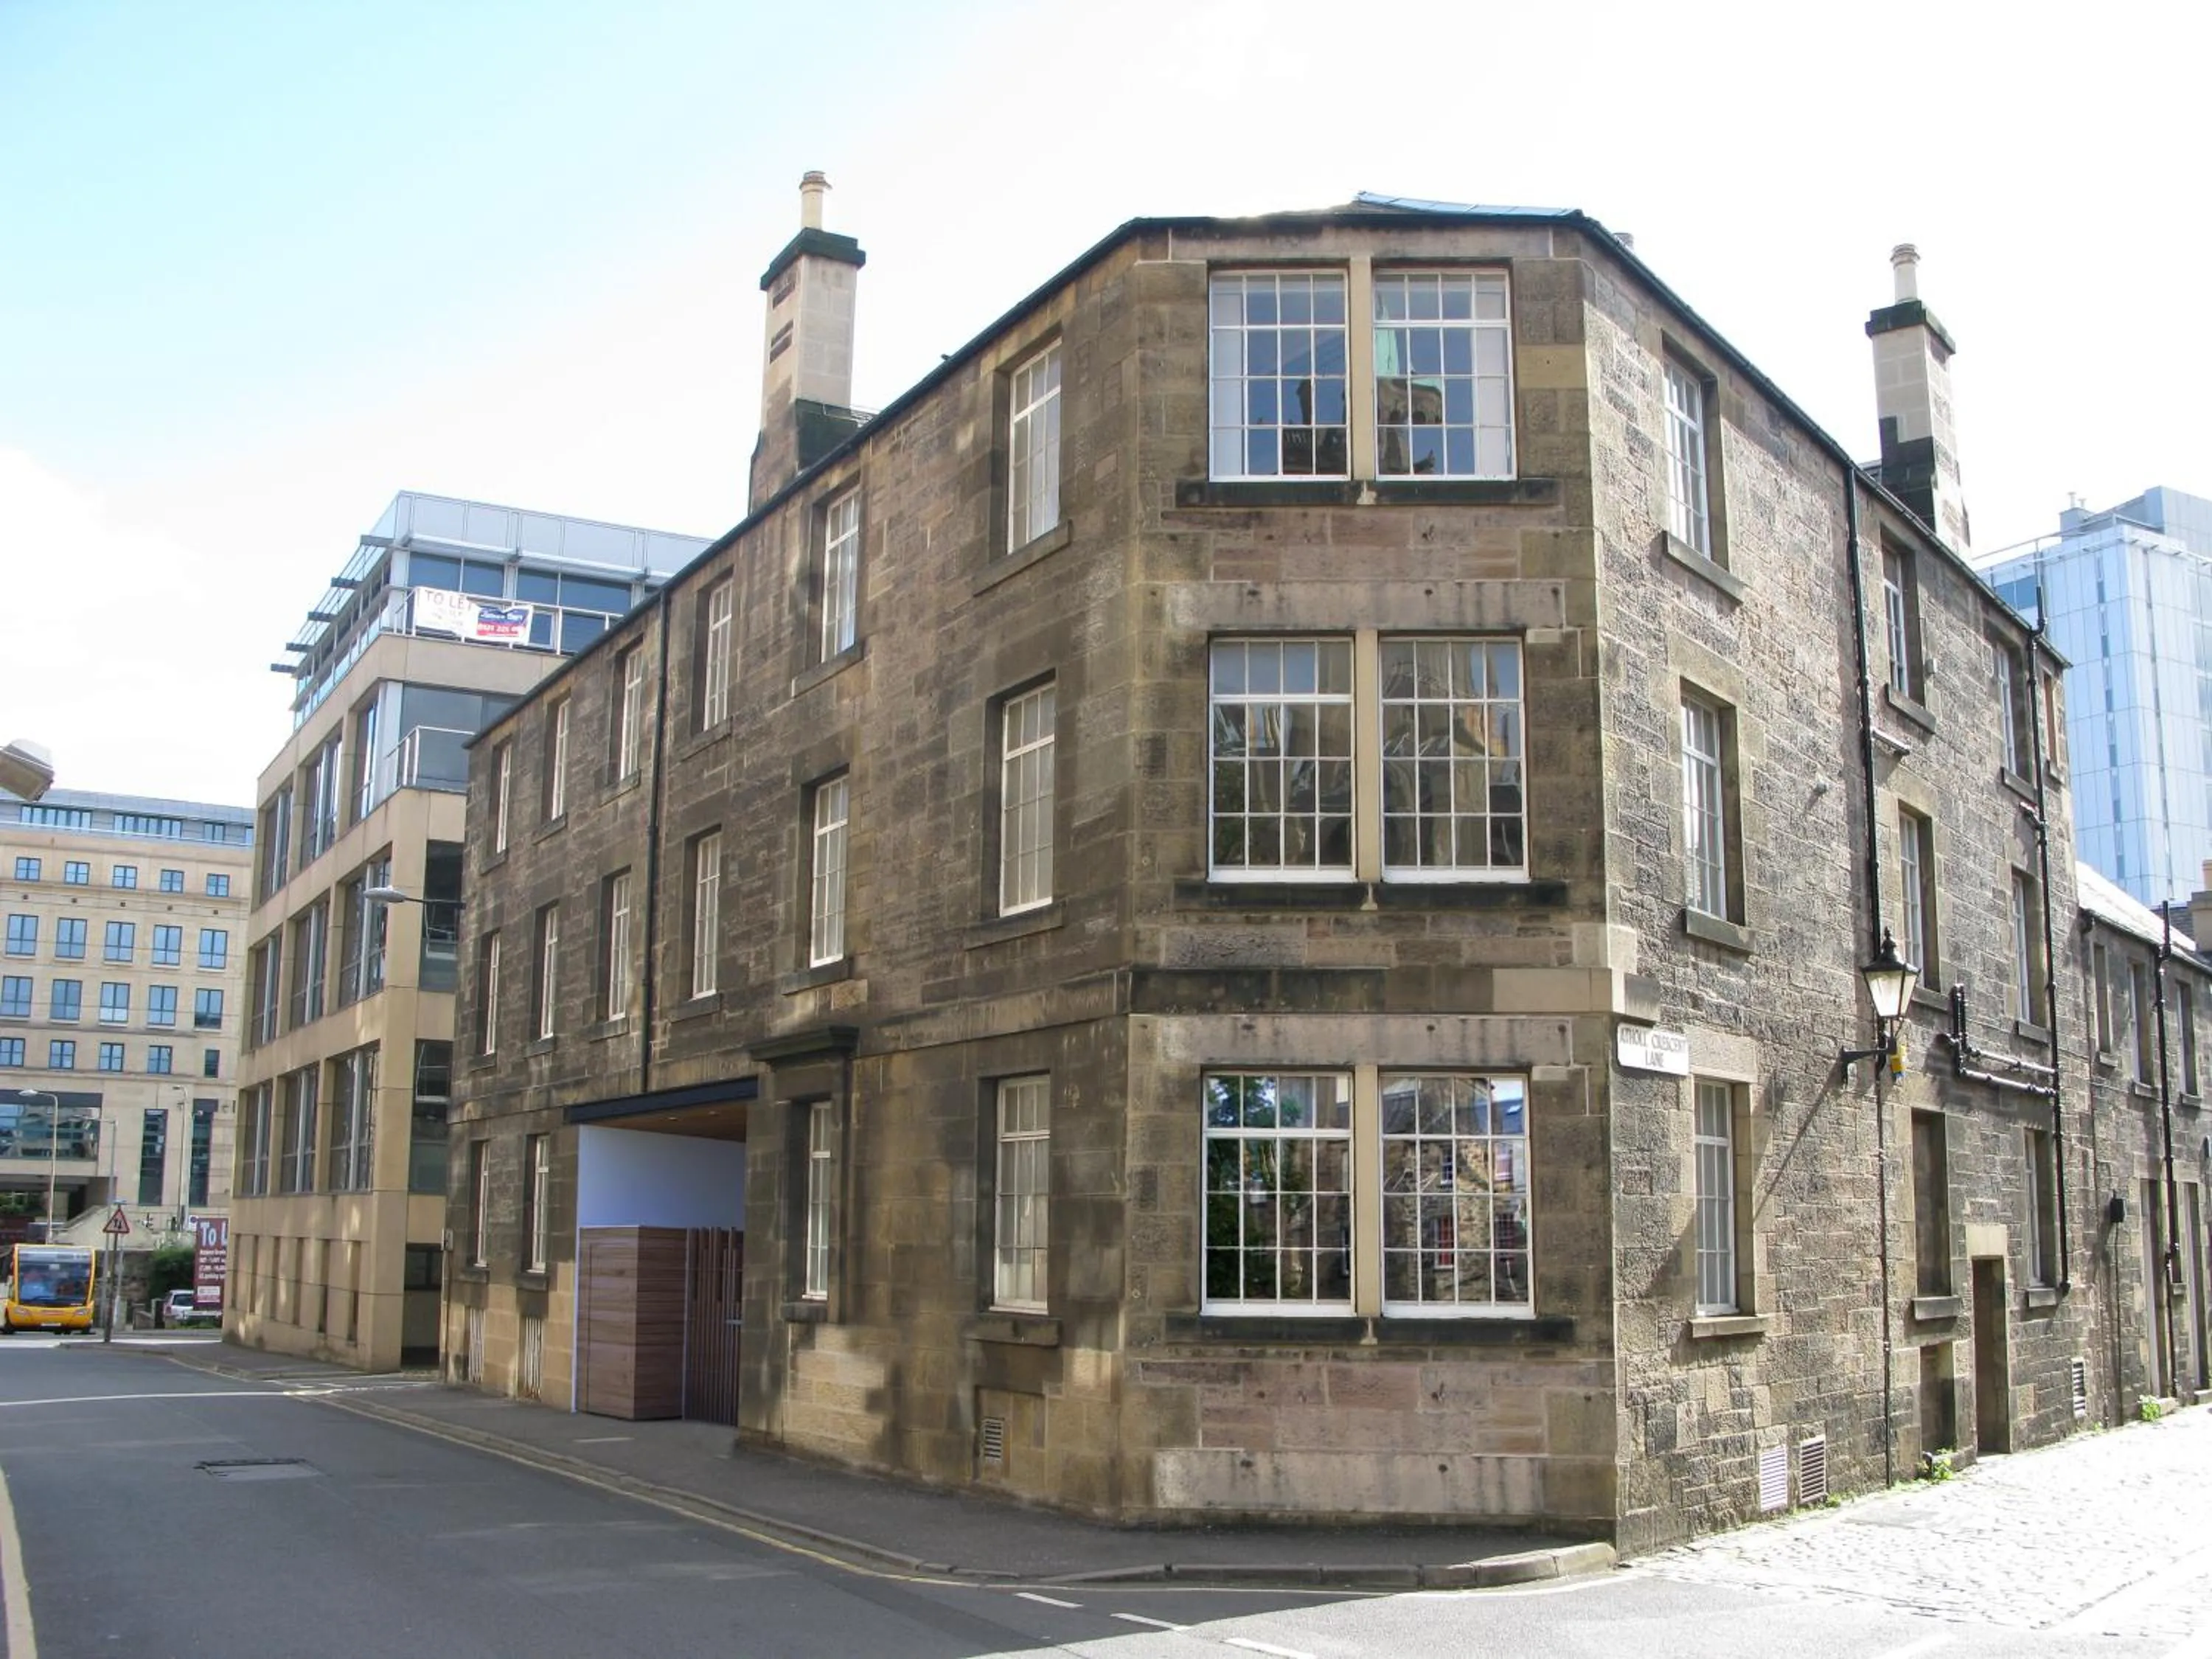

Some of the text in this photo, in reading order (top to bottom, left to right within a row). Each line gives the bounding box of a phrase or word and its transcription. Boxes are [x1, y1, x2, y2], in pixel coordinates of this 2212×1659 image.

[424, 589, 445, 605] TO
[1619, 1026, 1646, 1046] ATHOLL
[1645, 1049, 1664, 1068] LANE
[200, 1221, 217, 1246] To
